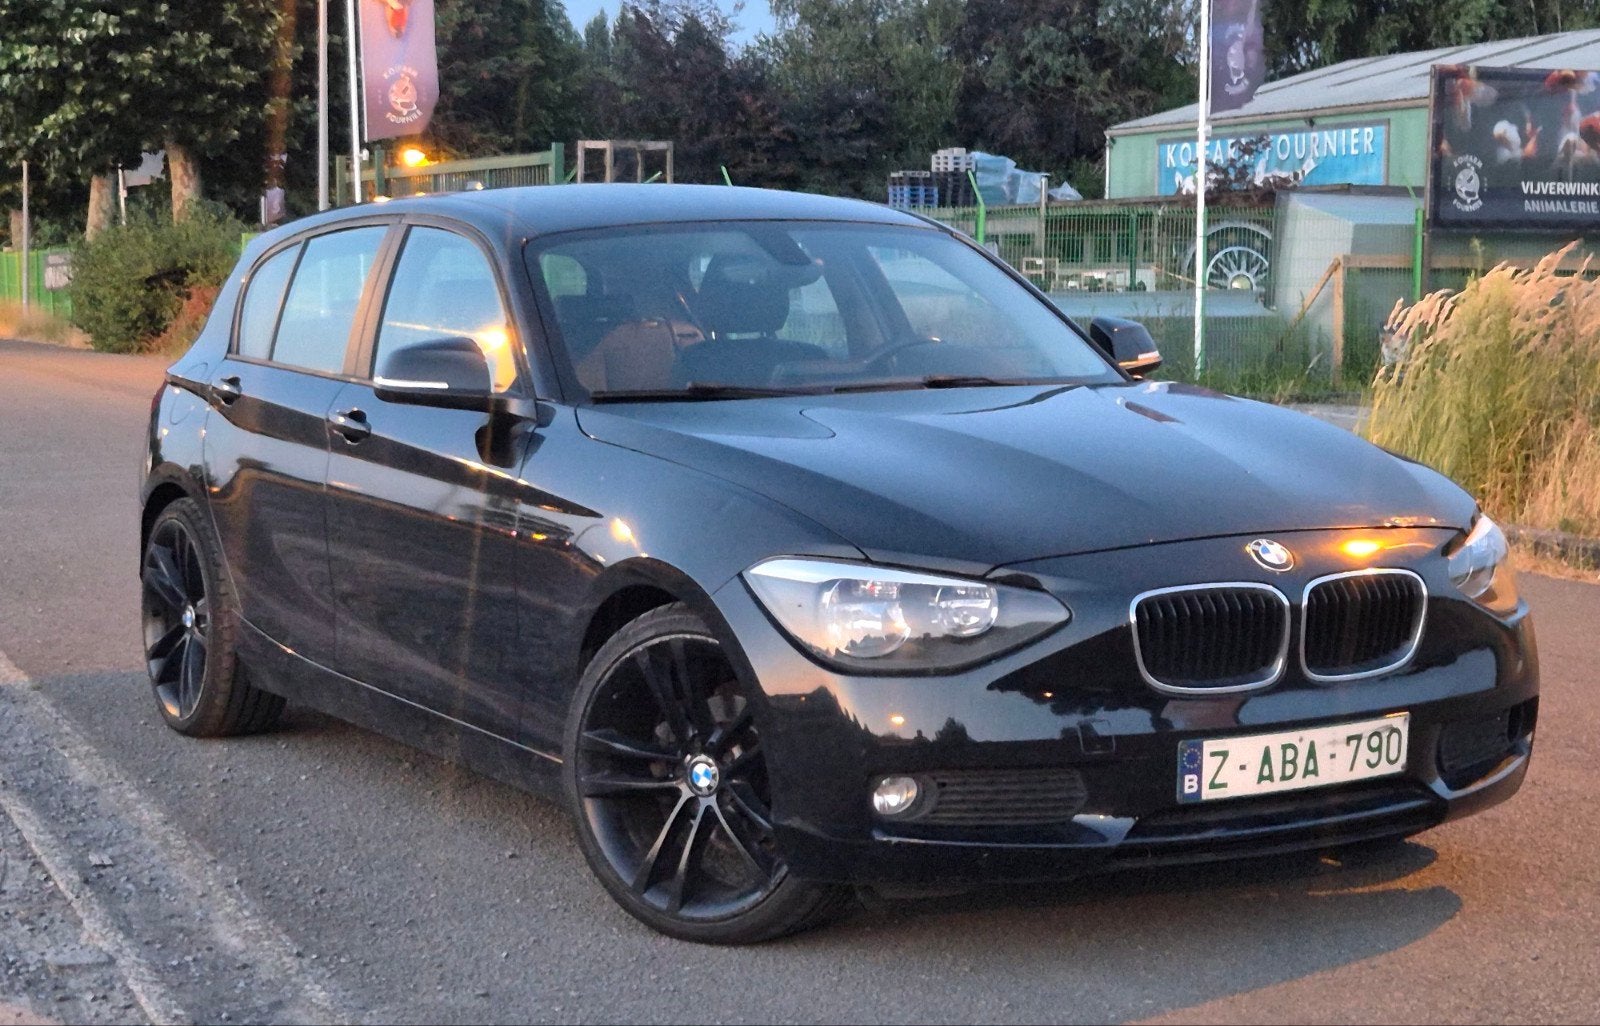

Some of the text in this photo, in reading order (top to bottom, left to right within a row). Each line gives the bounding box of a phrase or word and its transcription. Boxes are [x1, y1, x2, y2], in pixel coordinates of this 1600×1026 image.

[1521, 181, 1600, 196] VIJVERWINK
[1524, 200, 1600, 214] ANIMALERIE
[1183, 774, 1199, 793] B
